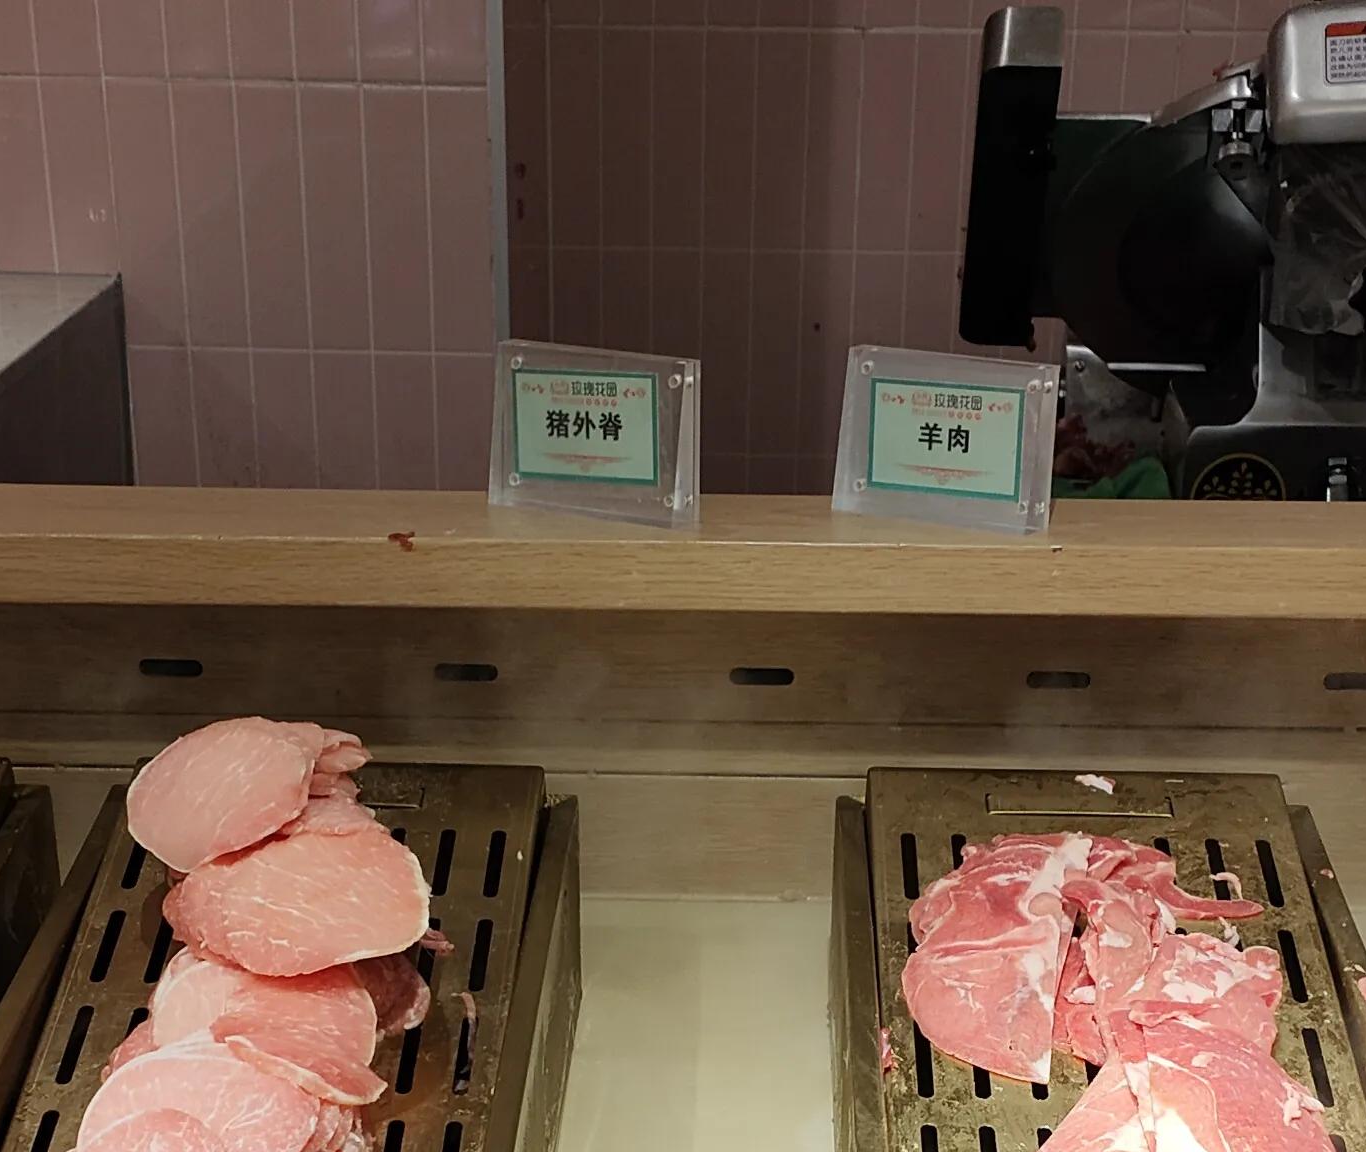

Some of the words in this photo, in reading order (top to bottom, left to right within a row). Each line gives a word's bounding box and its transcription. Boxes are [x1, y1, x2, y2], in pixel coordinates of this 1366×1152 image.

[546, 409, 622, 440] 猪外脊
[919, 422, 970, 453] 羊肉
